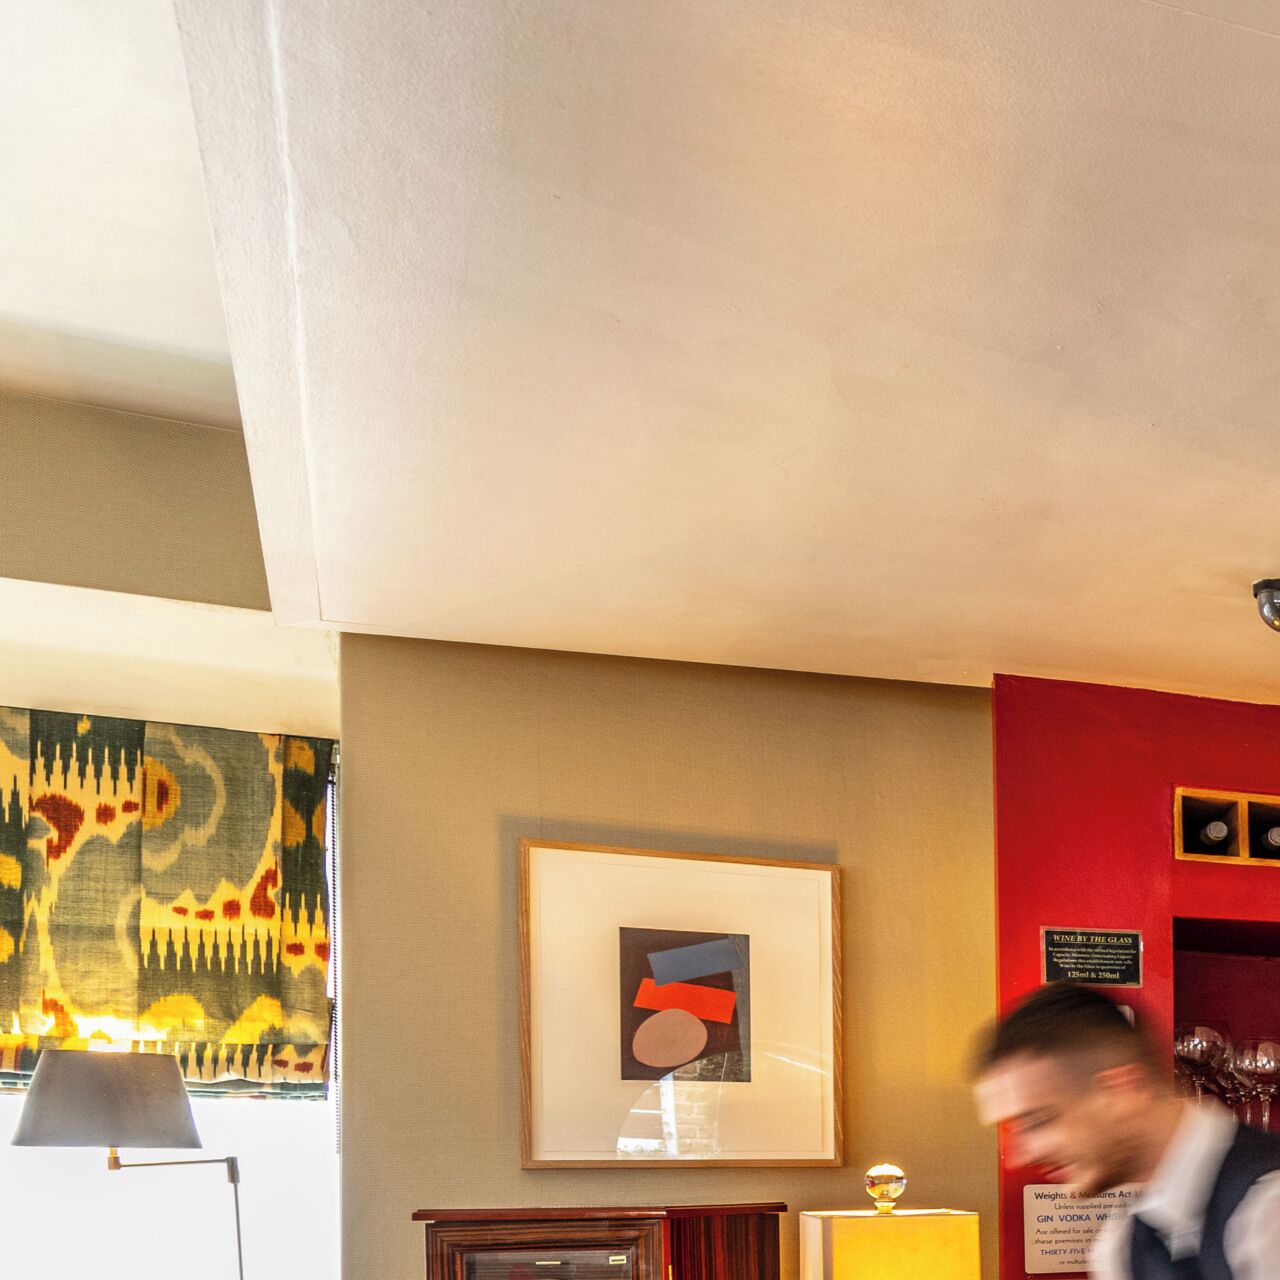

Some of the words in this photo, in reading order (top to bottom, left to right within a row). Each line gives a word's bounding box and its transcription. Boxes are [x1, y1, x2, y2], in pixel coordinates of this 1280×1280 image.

[1053, 934, 1076, 942] WINE
[1034, 1191, 1067, 1201] Weights
[1118, 1190, 1132, 1198] Act
[1037, 1214, 1054, 1223] GIN
[1059, 1214, 1091, 1222] VODKA
[1040, 1247, 1086, 1256] THIRTY-FIVE
